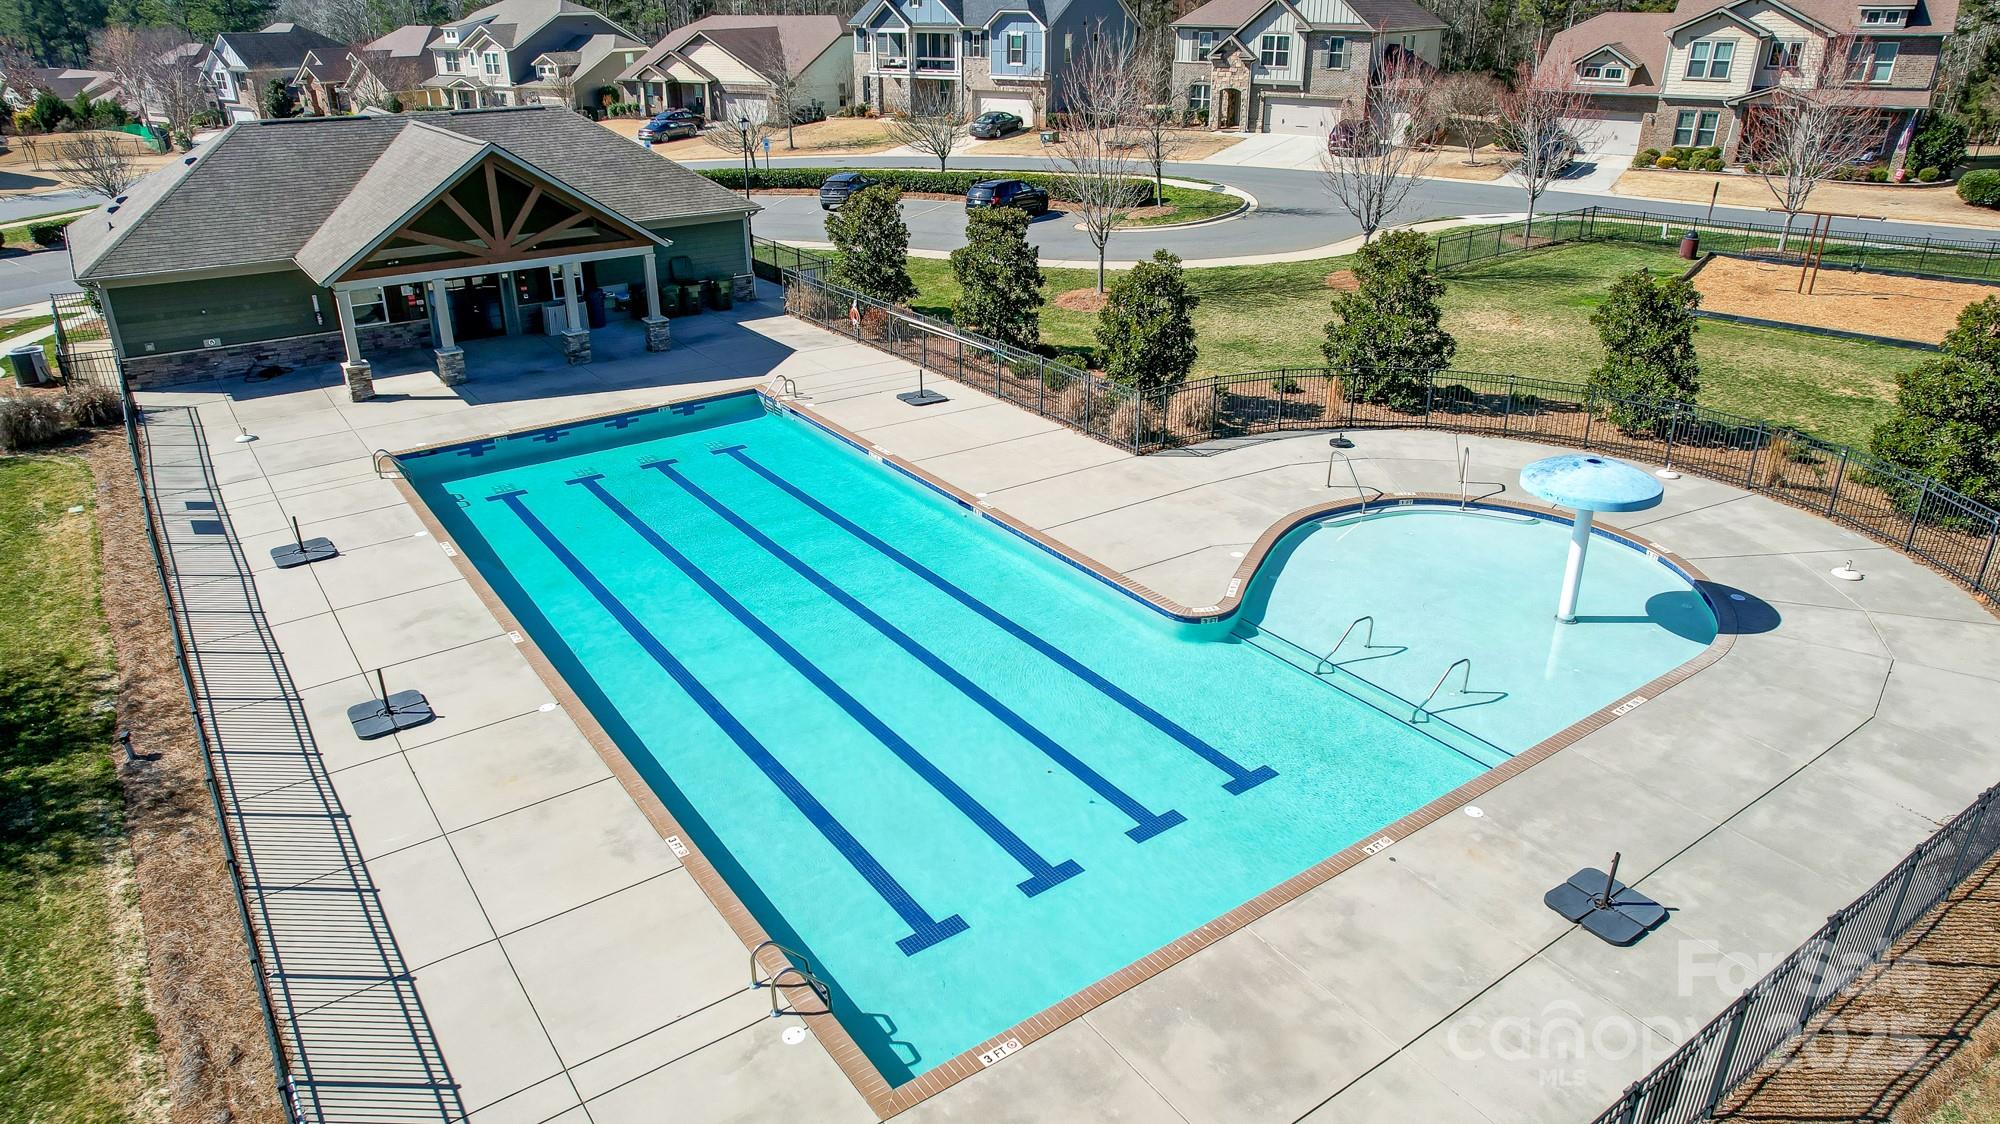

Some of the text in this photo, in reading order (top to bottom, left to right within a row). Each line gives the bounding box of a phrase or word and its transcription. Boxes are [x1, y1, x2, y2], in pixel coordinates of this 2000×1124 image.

[672, 842, 683, 850] FT
[1372, 842, 1384, 850] FT
[984, 1047, 1007, 1063] 3 FT
